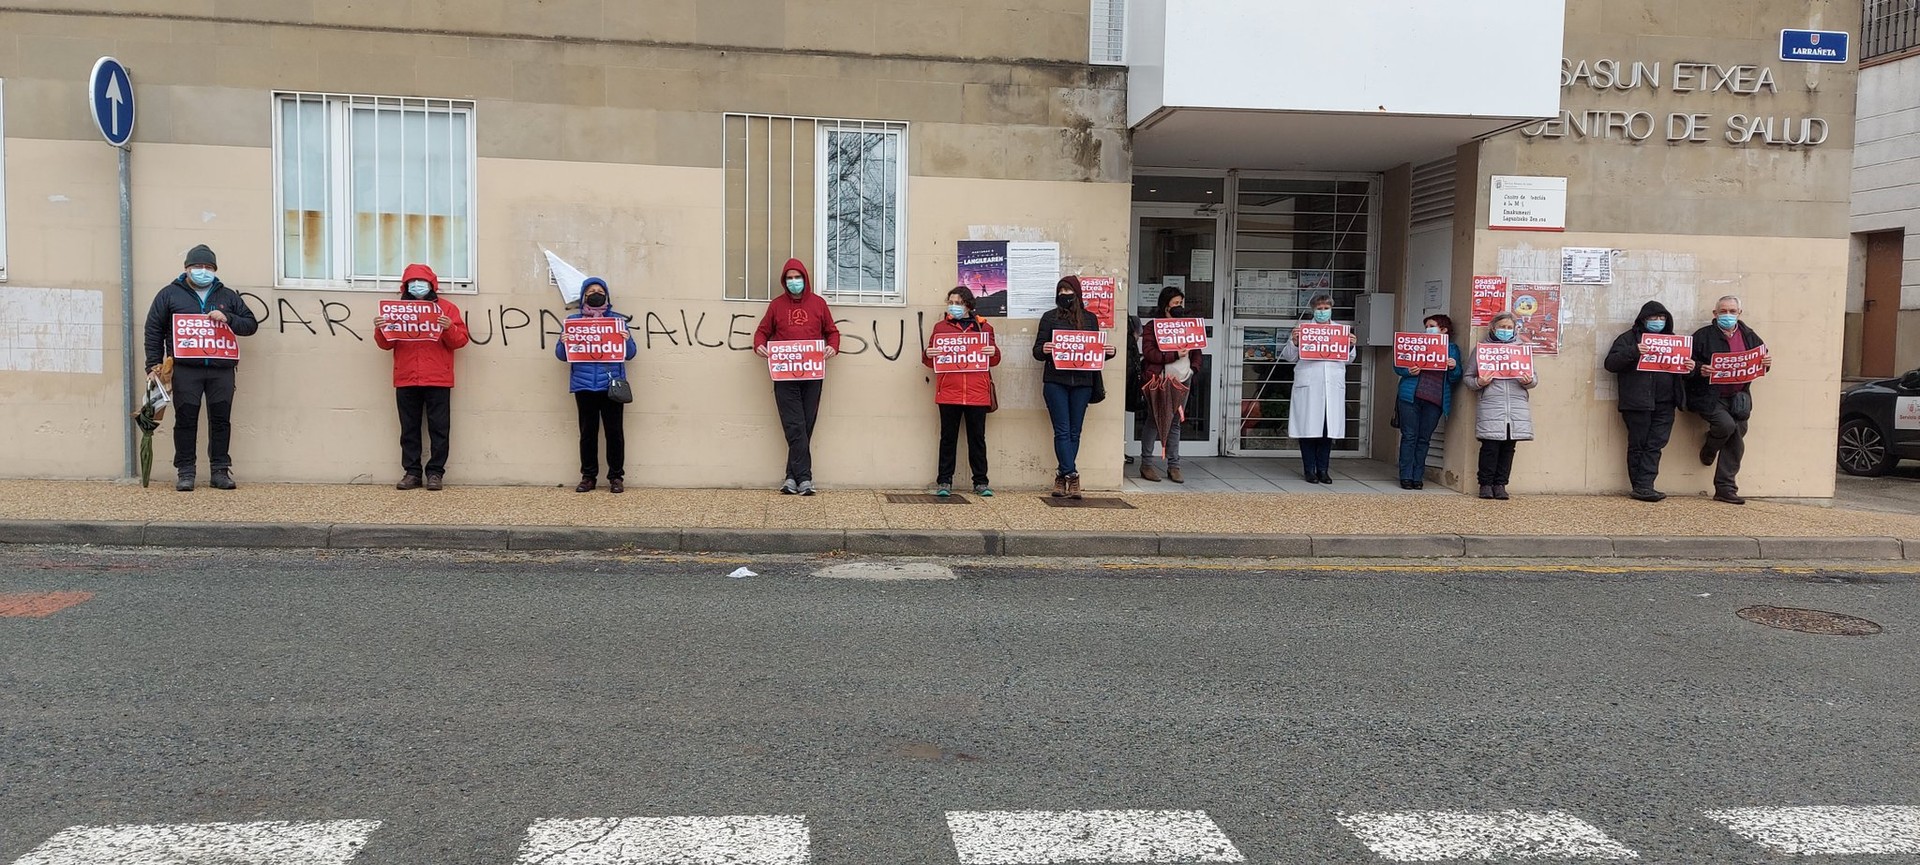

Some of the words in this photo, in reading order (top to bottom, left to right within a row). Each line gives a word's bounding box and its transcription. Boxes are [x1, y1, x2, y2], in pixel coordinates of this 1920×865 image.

[1792, 46, 1837, 56] LARRAÑETA
[1560, 57, 1660, 90] SASUN
[1672, 62, 1778, 94] ETXEA
[1666, 111, 1711, 142] DE
[1725, 113, 1830, 145] SALUD
[963, 255, 1004, 265] LANGILEAREN
[382, 303, 431, 314] osasun
[383, 312, 418, 321] etxea
[384, 320, 441, 332] zaindu
[567, 324, 613, 335] osasun
[1156, 320, 1195, 330] osasun
[1157, 326, 1185, 335] etxea
[177, 327, 215, 337] etxea
[569, 333, 600, 342] etxea
[1303, 327, 1341, 337] osasun
[178, 335, 237, 350] zaindu
[936, 335, 978, 346] osasun
[1055, 333, 1096, 344] osasun
[1159, 333, 1205, 345] zaindu
[1302, 334, 1330, 343] etxea
[1397, 335, 1439, 346] osasun
[1644, 337, 1683, 348] osasun
[568, 340, 622, 353] zaindu
[770, 343, 814, 354] osasun
[1055, 341, 1084, 350] etxea
[1301, 341, 1347, 353] zaindu
[1397, 343, 1427, 352] etxea
[1479, 345, 1521, 356] osasun
[771, 351, 802, 361] etxea
[936, 351, 987, 364] zaindu
[1054, 349, 1103, 362] zaindu
[1397, 350, 1446, 363] zaindu
[1479, 352, 1509, 361] etxea
[1714, 351, 1759, 364] osasun
[772, 358, 823, 372] zaindu
[1479, 360, 1530, 372] zaindu
[1714, 361, 1747, 370] etxea
